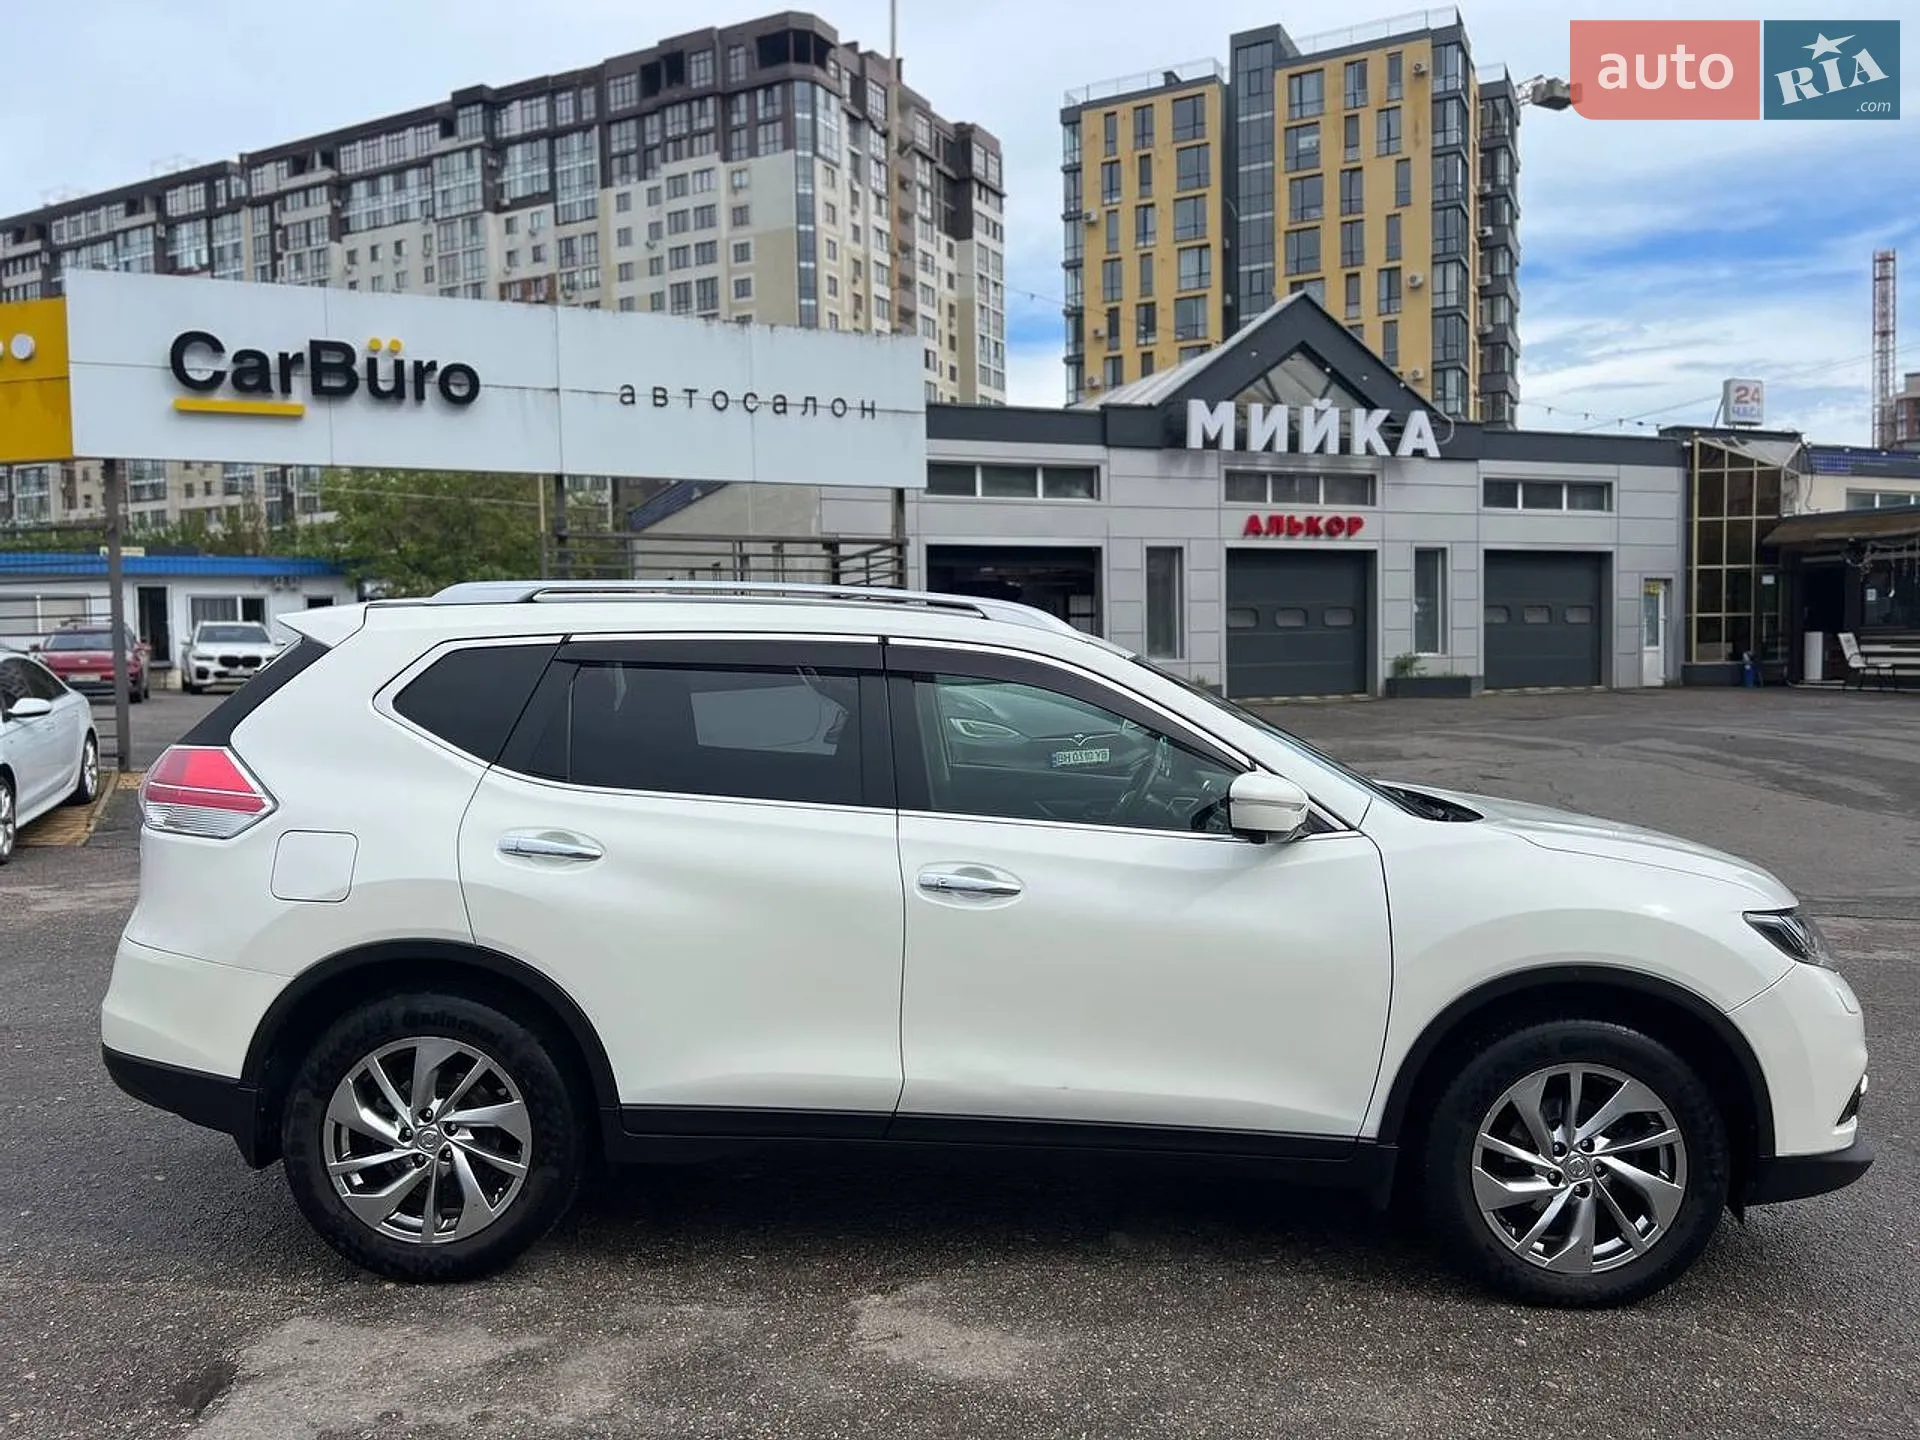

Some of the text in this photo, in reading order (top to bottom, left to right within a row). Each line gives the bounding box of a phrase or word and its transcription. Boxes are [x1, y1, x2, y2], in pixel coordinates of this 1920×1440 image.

[170, 330, 480, 405] CarBüro
[619, 383, 876, 420] автосалон
[1735, 386, 1760, 405] 24
[1186, 398, 1441, 458] МИЙКА
[1243, 514, 1365, 538] АЛЬКОР
